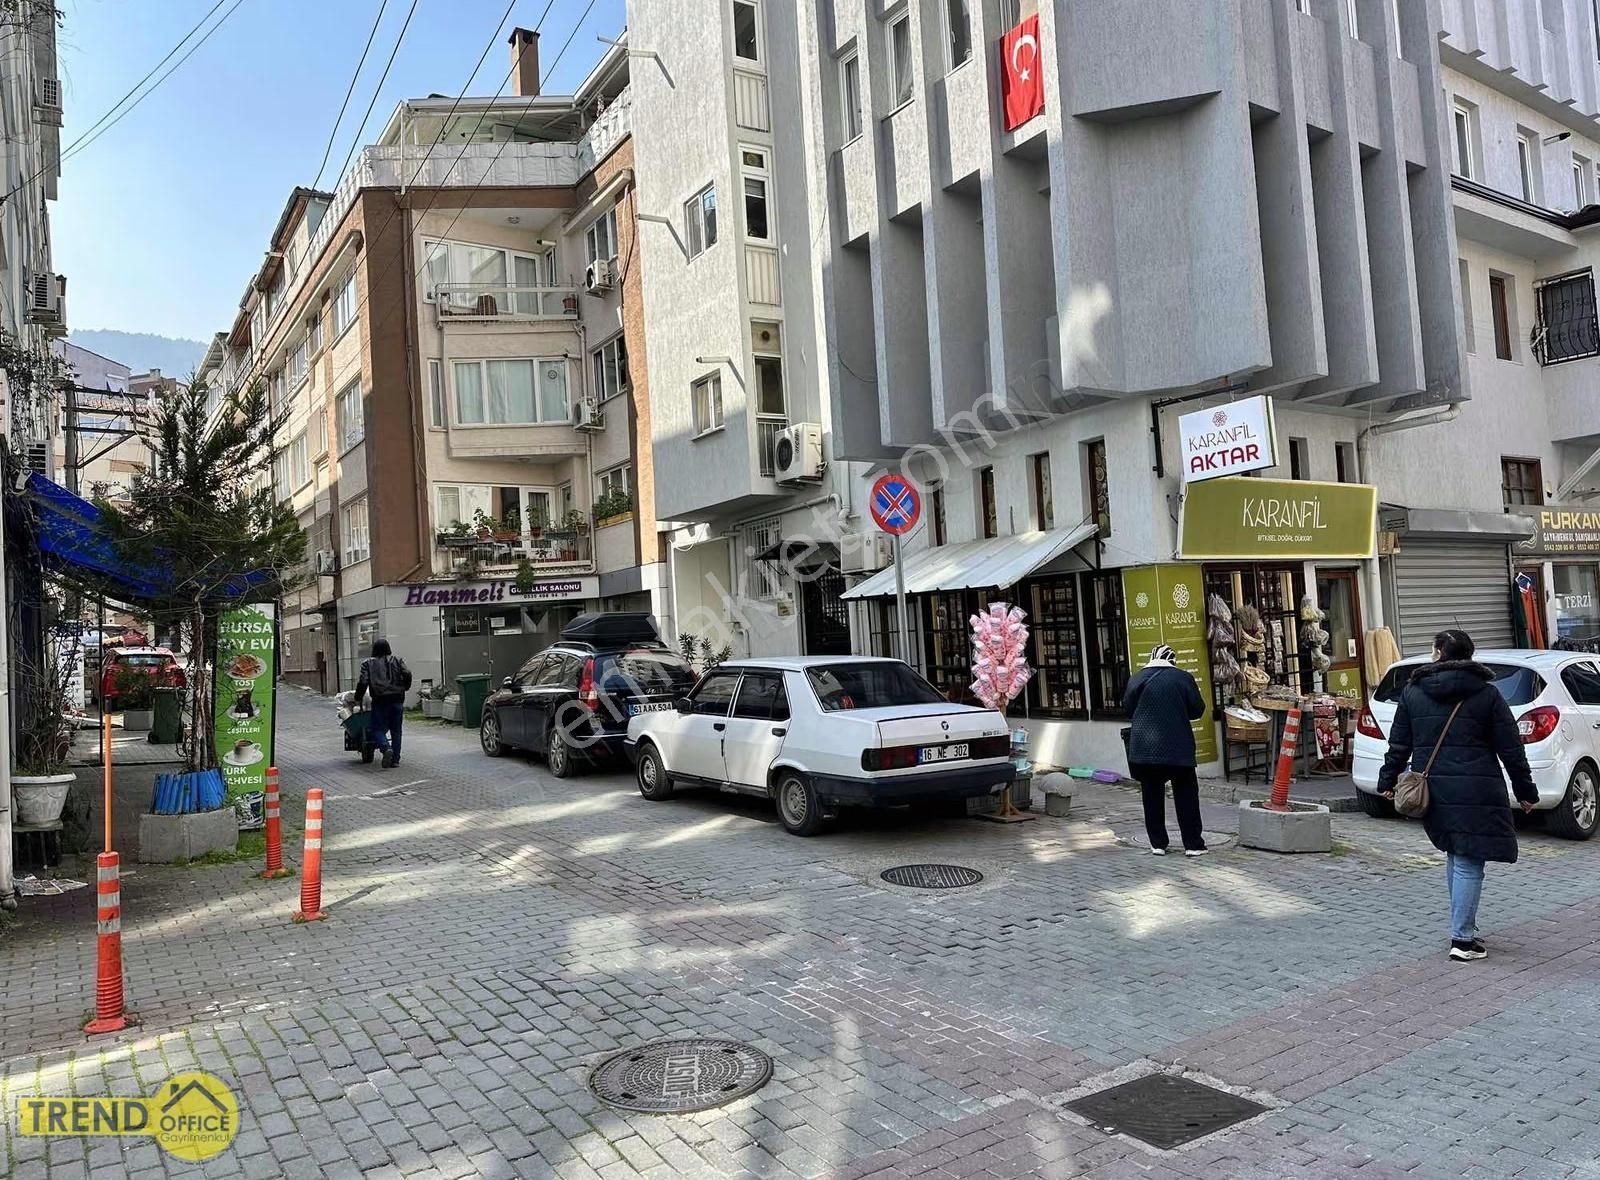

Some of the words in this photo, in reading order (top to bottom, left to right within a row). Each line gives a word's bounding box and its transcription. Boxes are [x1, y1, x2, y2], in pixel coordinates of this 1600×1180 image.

[1189, 422, 1257, 452] KARANFİL
[1190, 443, 1260, 473] AKTAR
[1242, 495, 1327, 529] KARANFİL
[1541, 511, 1600, 529] FURKAN
[550, 584, 580, 592] SALONU
[1564, 591, 1592, 609] TERZİ
[250, 635, 274, 650] EVİ
[643, 703, 658, 712] AAK
[923, 749, 932, 760] 16
[937, 747, 947, 759] NE
[953, 745, 968, 757] 302
[224, 774, 262, 785] AHVESİ
